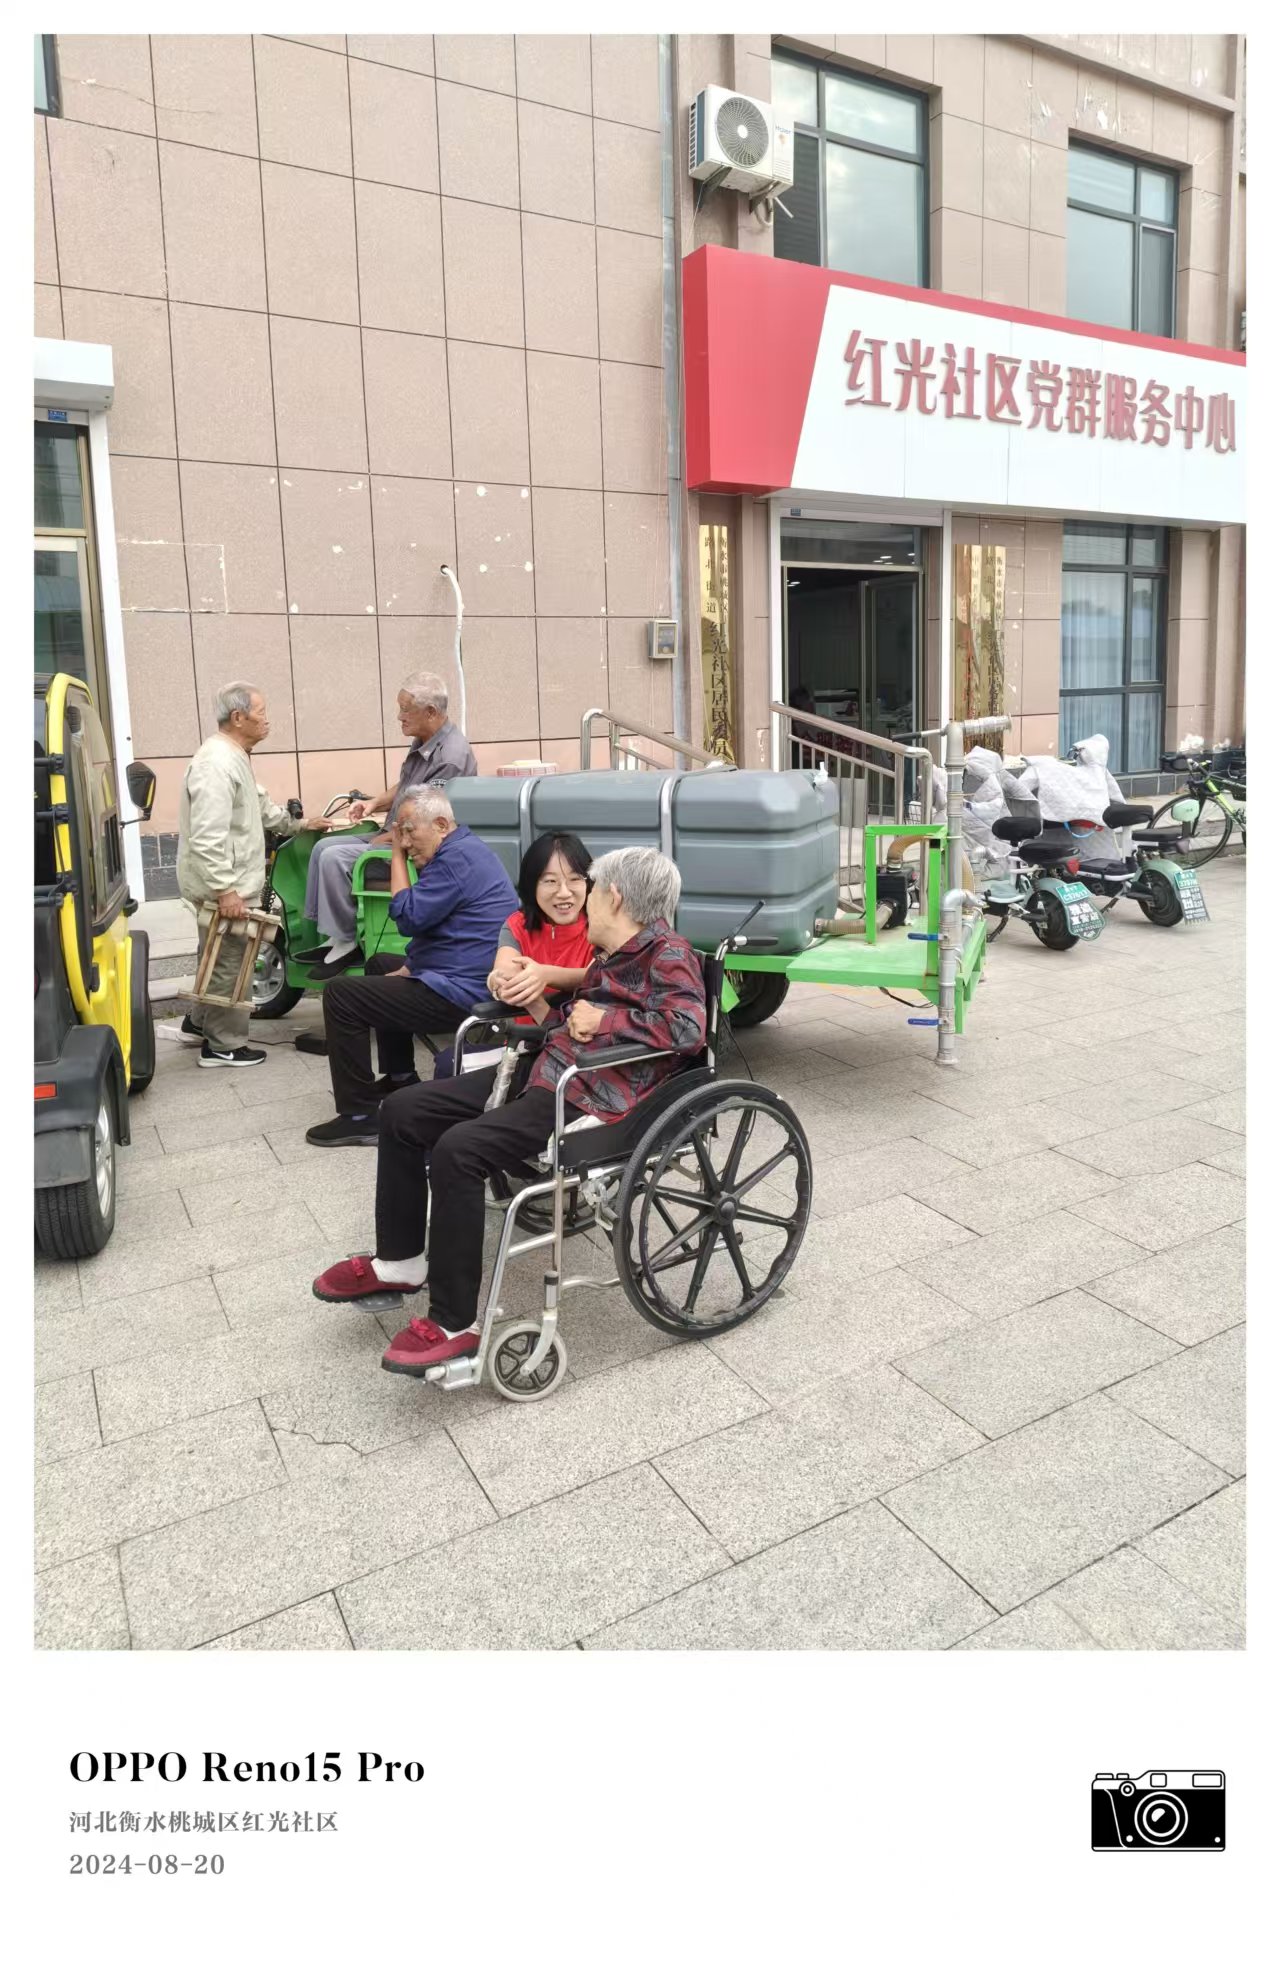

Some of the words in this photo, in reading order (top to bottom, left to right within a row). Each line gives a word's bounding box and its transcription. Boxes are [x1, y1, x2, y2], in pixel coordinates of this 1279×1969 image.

[843, 329, 1237, 454] 红光社区党群服务中心
